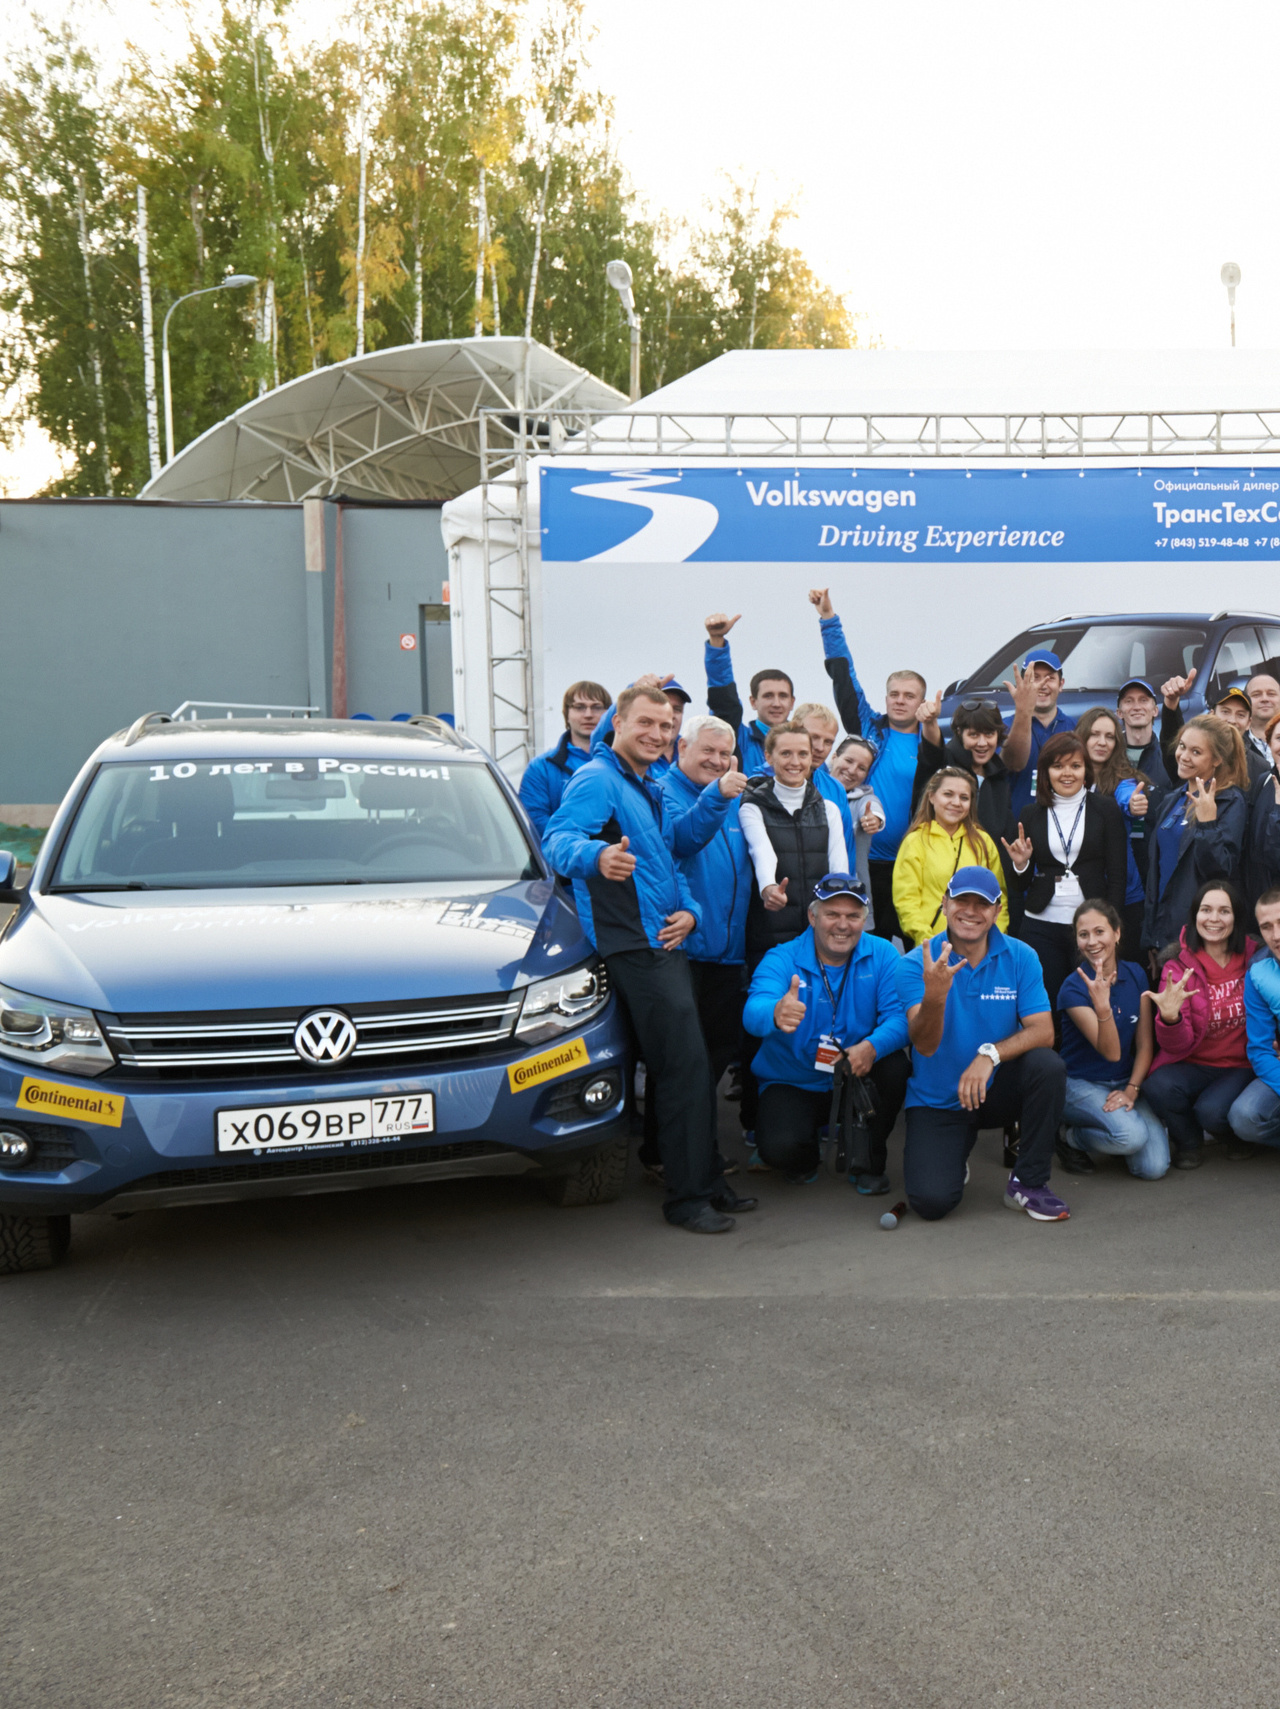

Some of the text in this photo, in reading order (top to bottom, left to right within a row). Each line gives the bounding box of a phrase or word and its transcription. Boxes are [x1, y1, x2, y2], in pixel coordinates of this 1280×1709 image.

[745, 480, 917, 513] Volkswagen
[1154, 479, 1240, 493] Официальный
[1243, 482, 1280, 493] дилер
[818, 524, 1065, 553] Driving Experience
[1154, 538, 1169, 548] +7
[1170, 537, 1196, 549] (843)
[1198, 537, 1250, 548] 519-48-48
[1254, 537, 1268, 547] +7
[149, 758, 451, 782] 10 лет в России!
[513, 1048, 574, 1085] Continental
[25, 1085, 103, 1114] Continental
[374, 1098, 423, 1124] 777
[386, 1121, 411, 1132] RUS
